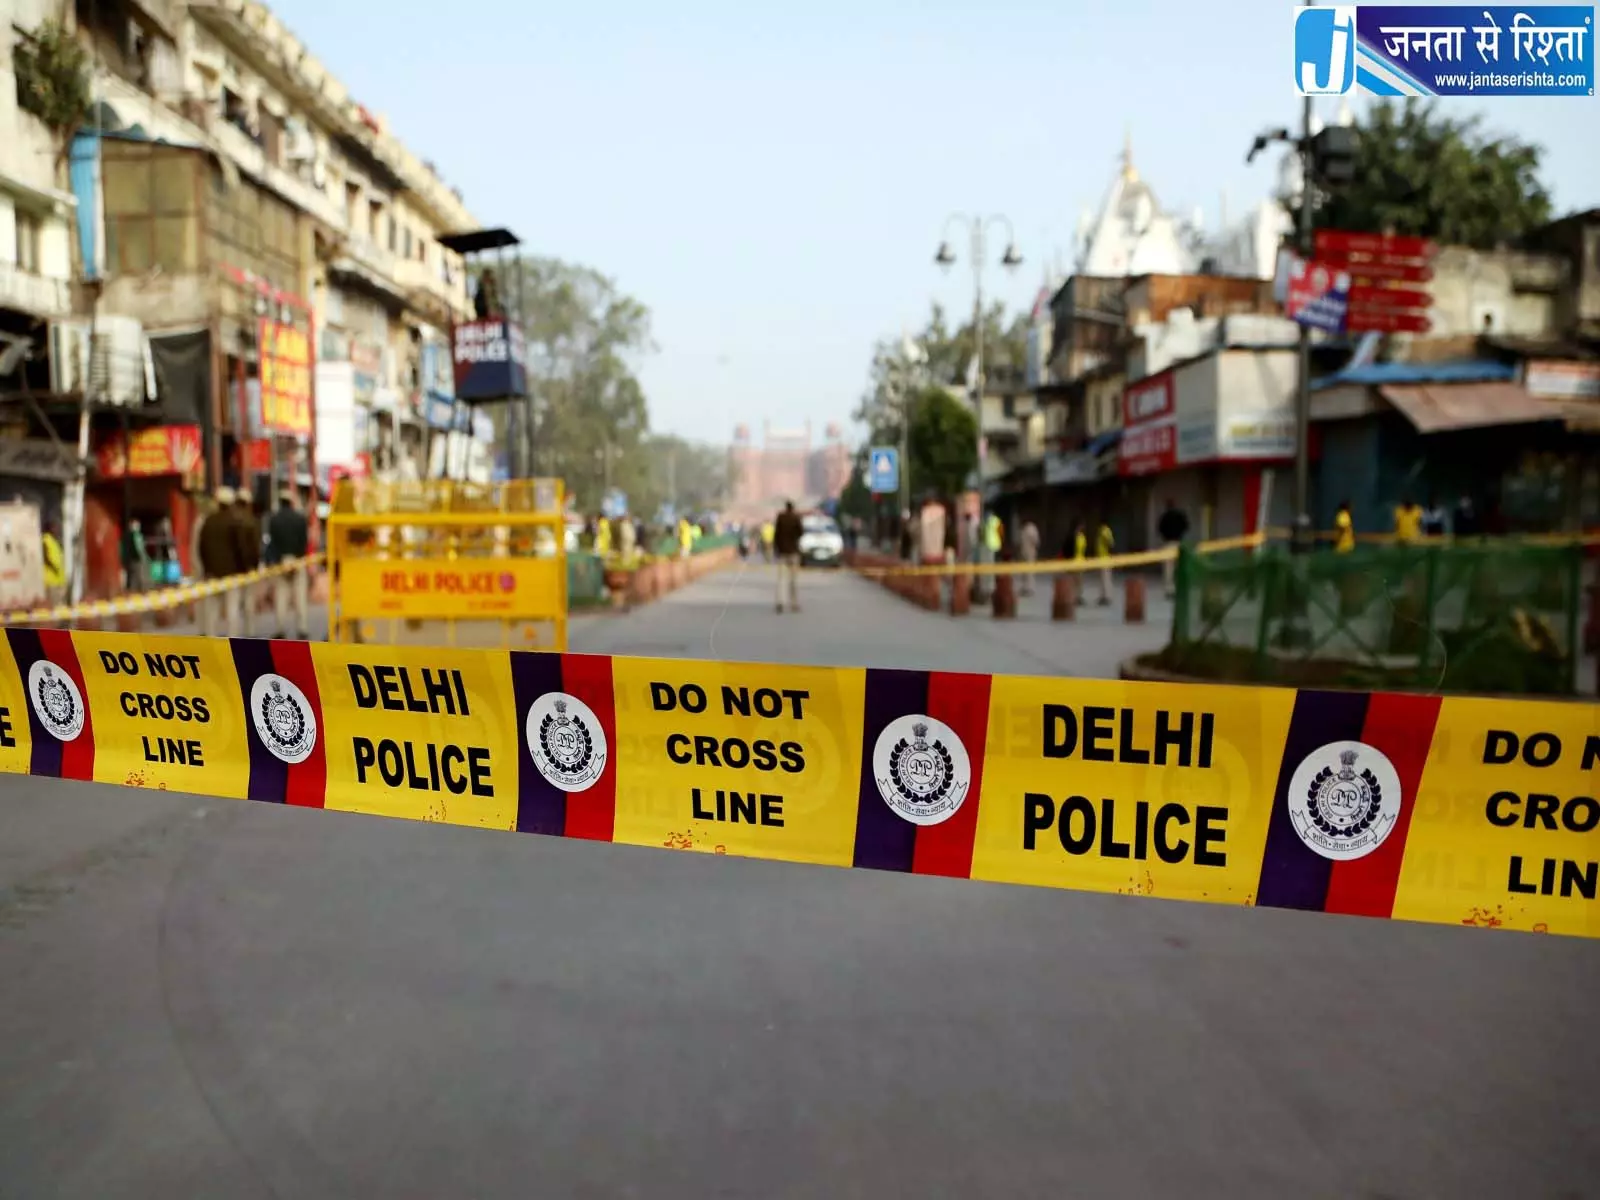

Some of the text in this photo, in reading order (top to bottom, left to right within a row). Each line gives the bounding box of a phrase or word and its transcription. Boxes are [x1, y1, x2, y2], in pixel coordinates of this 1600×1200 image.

[98, 650, 201, 679] DO NOT
[120, 691, 210, 723] CROSS
[347, 663, 470, 716] DELHI
[650, 681, 810, 720] DO NOT
[142, 735, 205, 767] LINE
[666, 733, 806, 773] CROSS
[1042, 703, 1214, 768] DELHI
[1482, 729, 1562, 768] DO
[352, 736, 495, 797] POLICE
[691, 788, 785, 827] LINE
[1023, 792, 1229, 867] POLICE
